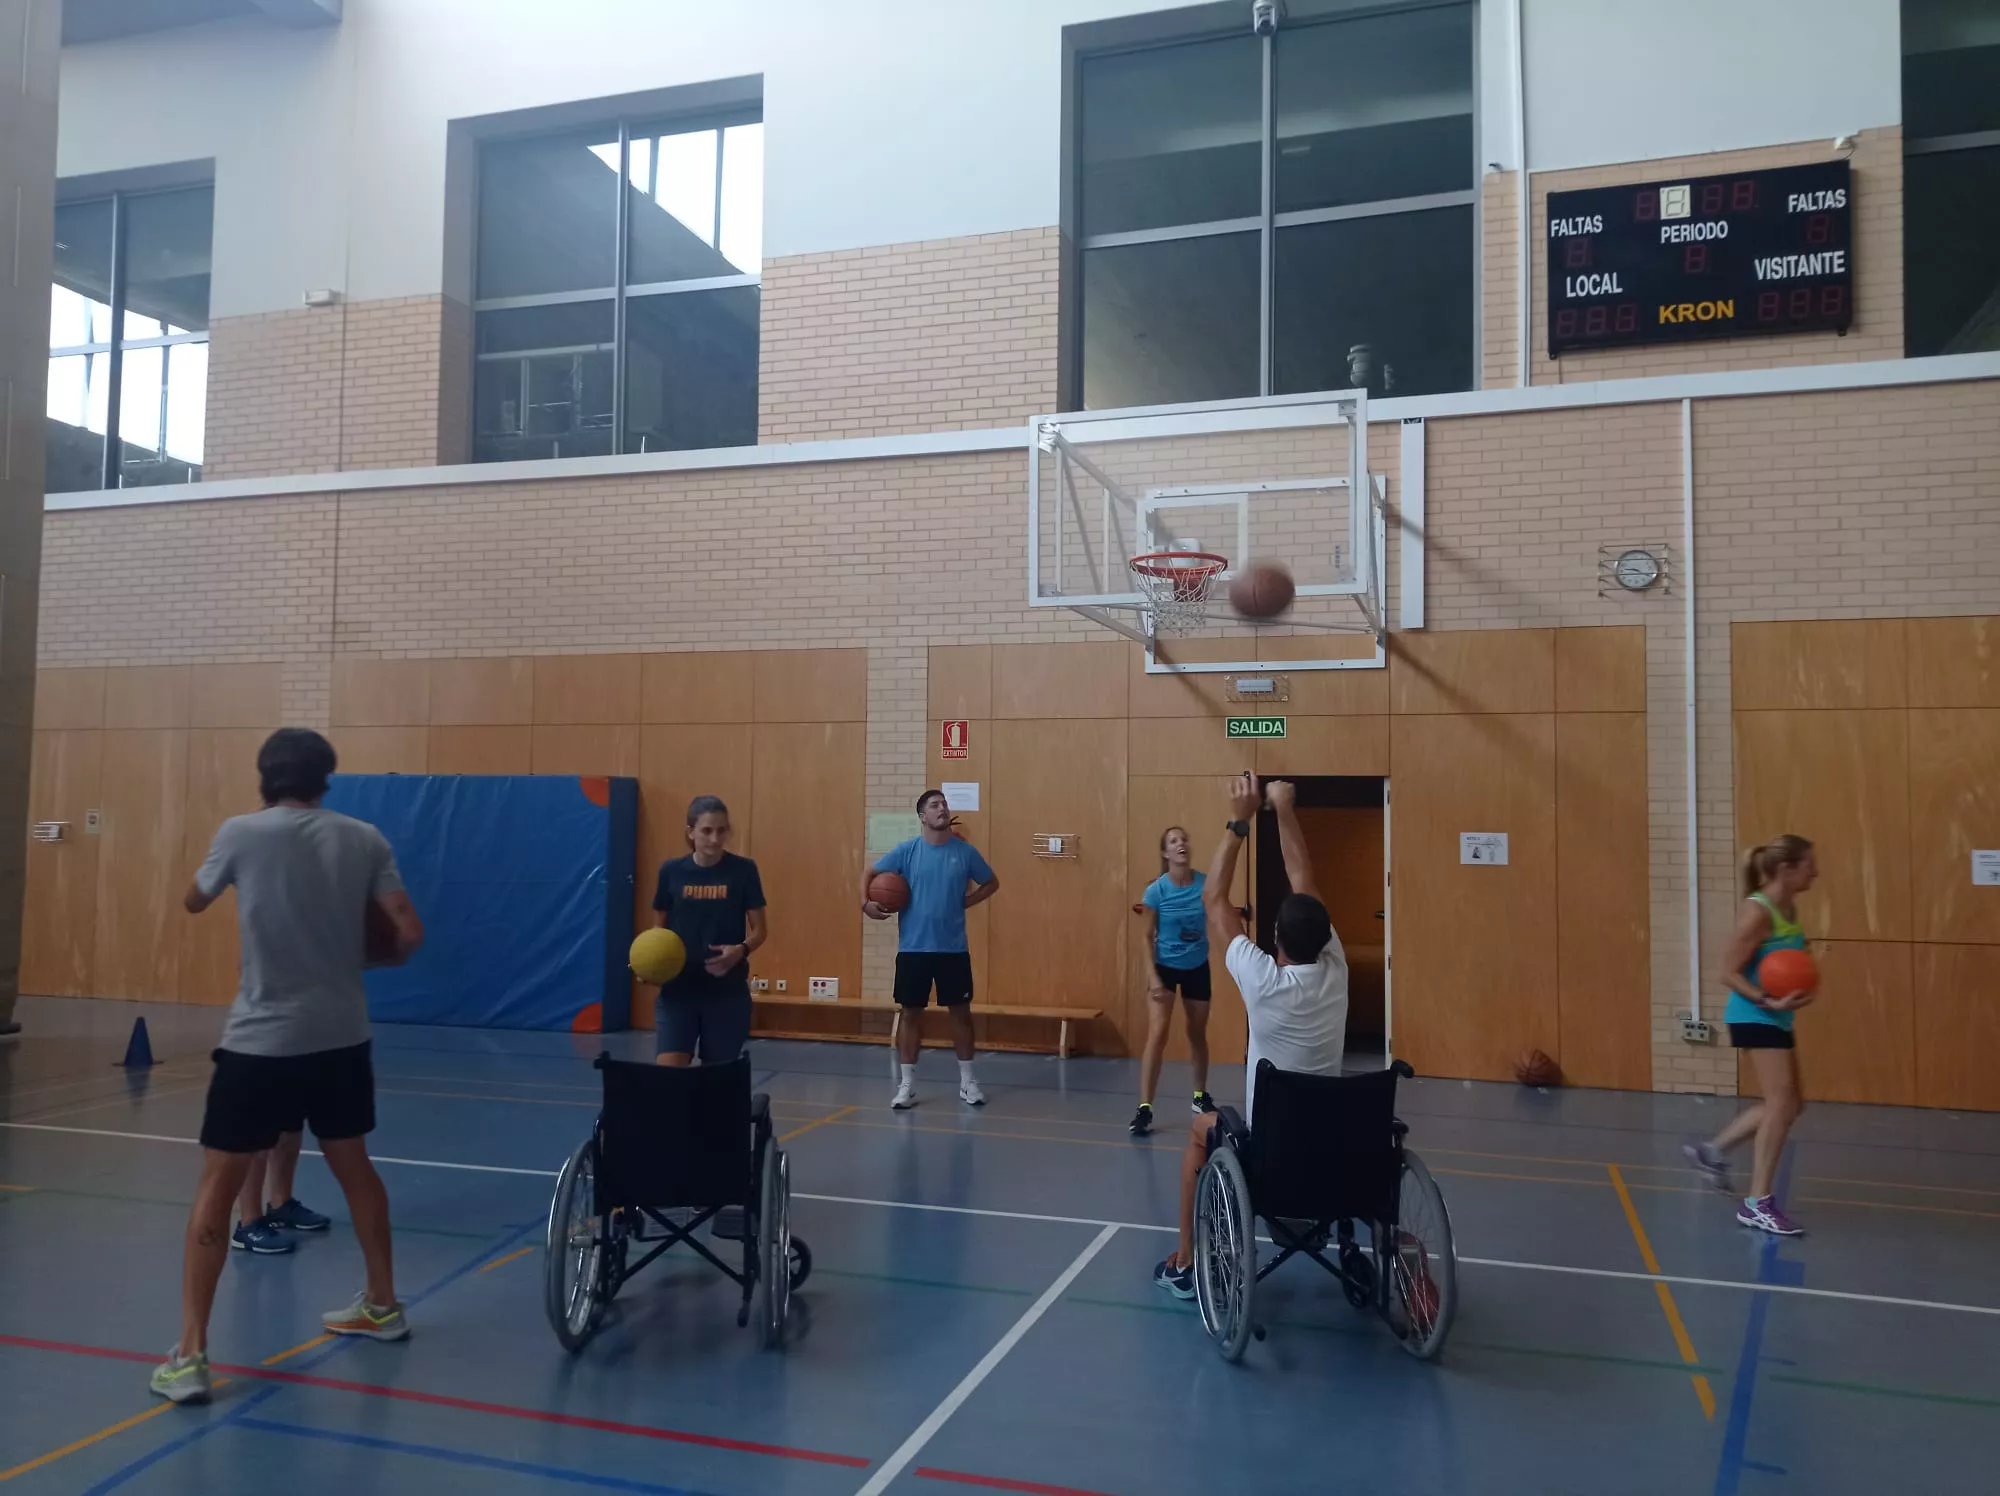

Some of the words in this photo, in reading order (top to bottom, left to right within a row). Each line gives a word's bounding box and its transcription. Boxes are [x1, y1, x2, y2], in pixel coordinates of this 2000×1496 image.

[1788, 189, 1847, 213] FALTAS
[1551, 215, 1603, 238] FALTAS
[1660, 220, 1728, 244] PERIODO
[1754, 250, 1846, 280] VISITANTE
[1566, 272, 1623, 298] LOCAL
[1658, 300, 1735, 324] KRON
[1229, 721, 1284, 734] SALIDA
